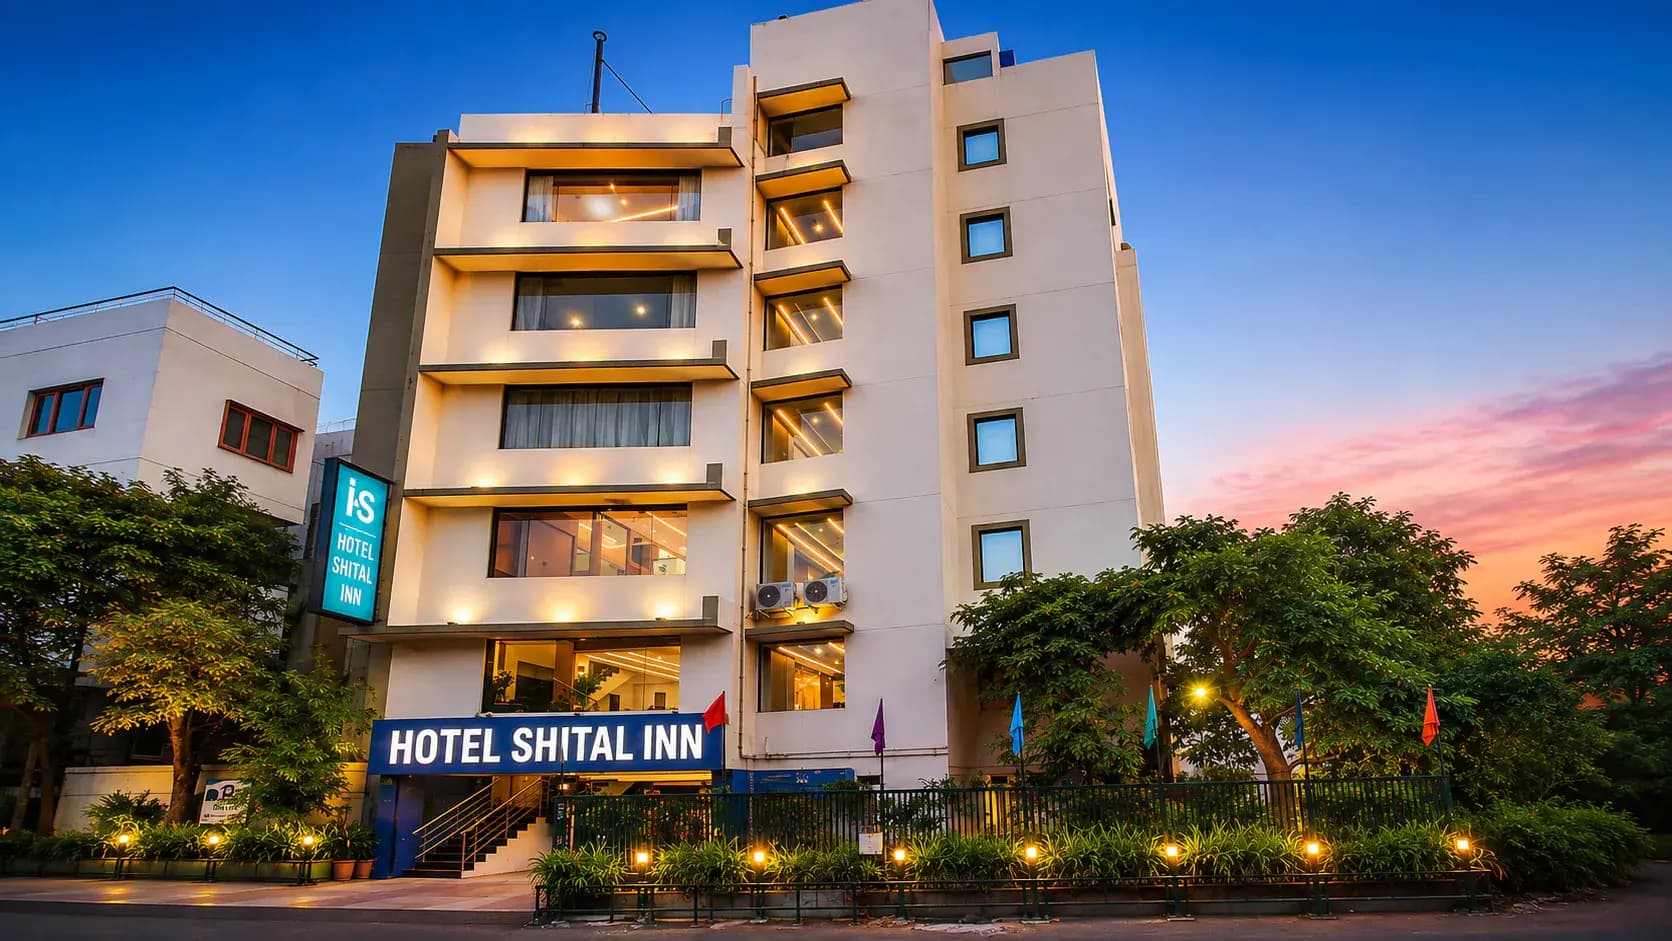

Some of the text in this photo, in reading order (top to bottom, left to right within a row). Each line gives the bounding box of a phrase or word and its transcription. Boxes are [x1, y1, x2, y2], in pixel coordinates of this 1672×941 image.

[337, 532, 374, 561] HOTEL
[332, 557, 372, 585] SHITAL
[340, 583, 362, 606] INN
[388, 724, 703, 765] HOTEL SHITAL INN
